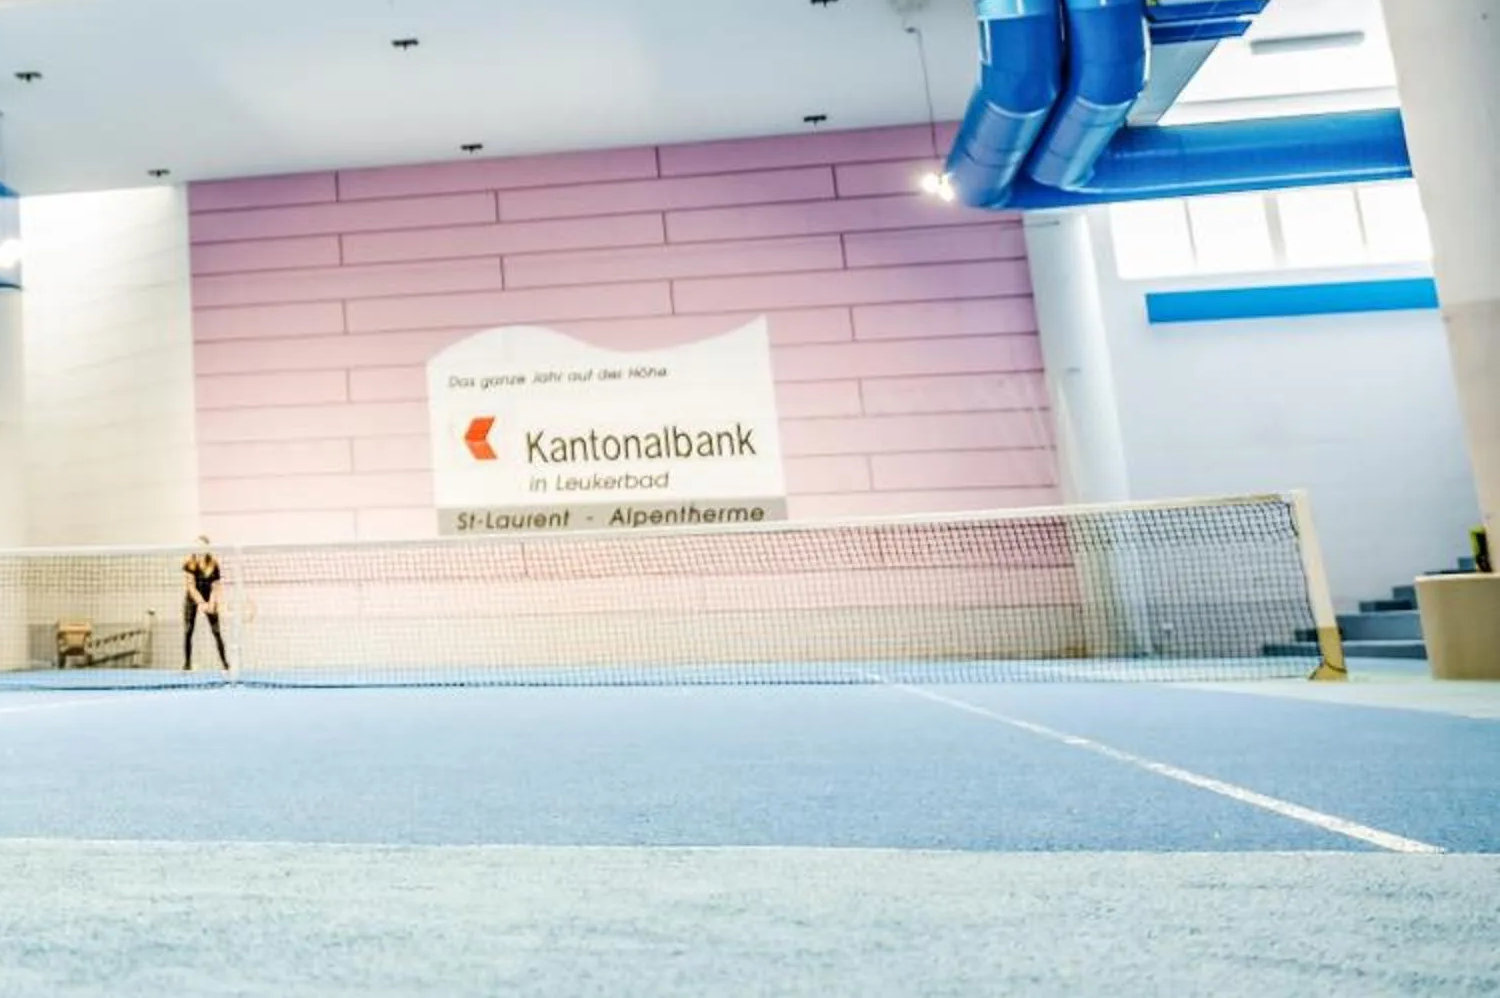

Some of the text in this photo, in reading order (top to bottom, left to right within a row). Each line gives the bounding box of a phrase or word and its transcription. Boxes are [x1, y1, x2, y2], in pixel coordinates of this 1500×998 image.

[448, 375, 475, 388] Das
[481, 374, 526, 389] ganze
[531, 370, 563, 384] Jahr
[567, 369, 593, 383] auf
[525, 422, 757, 463] Kantonalbank
[529, 472, 670, 492] in Leukerbad
[456, 509, 570, 531] St-Laurent
[609, 505, 765, 528] Alpentherme
